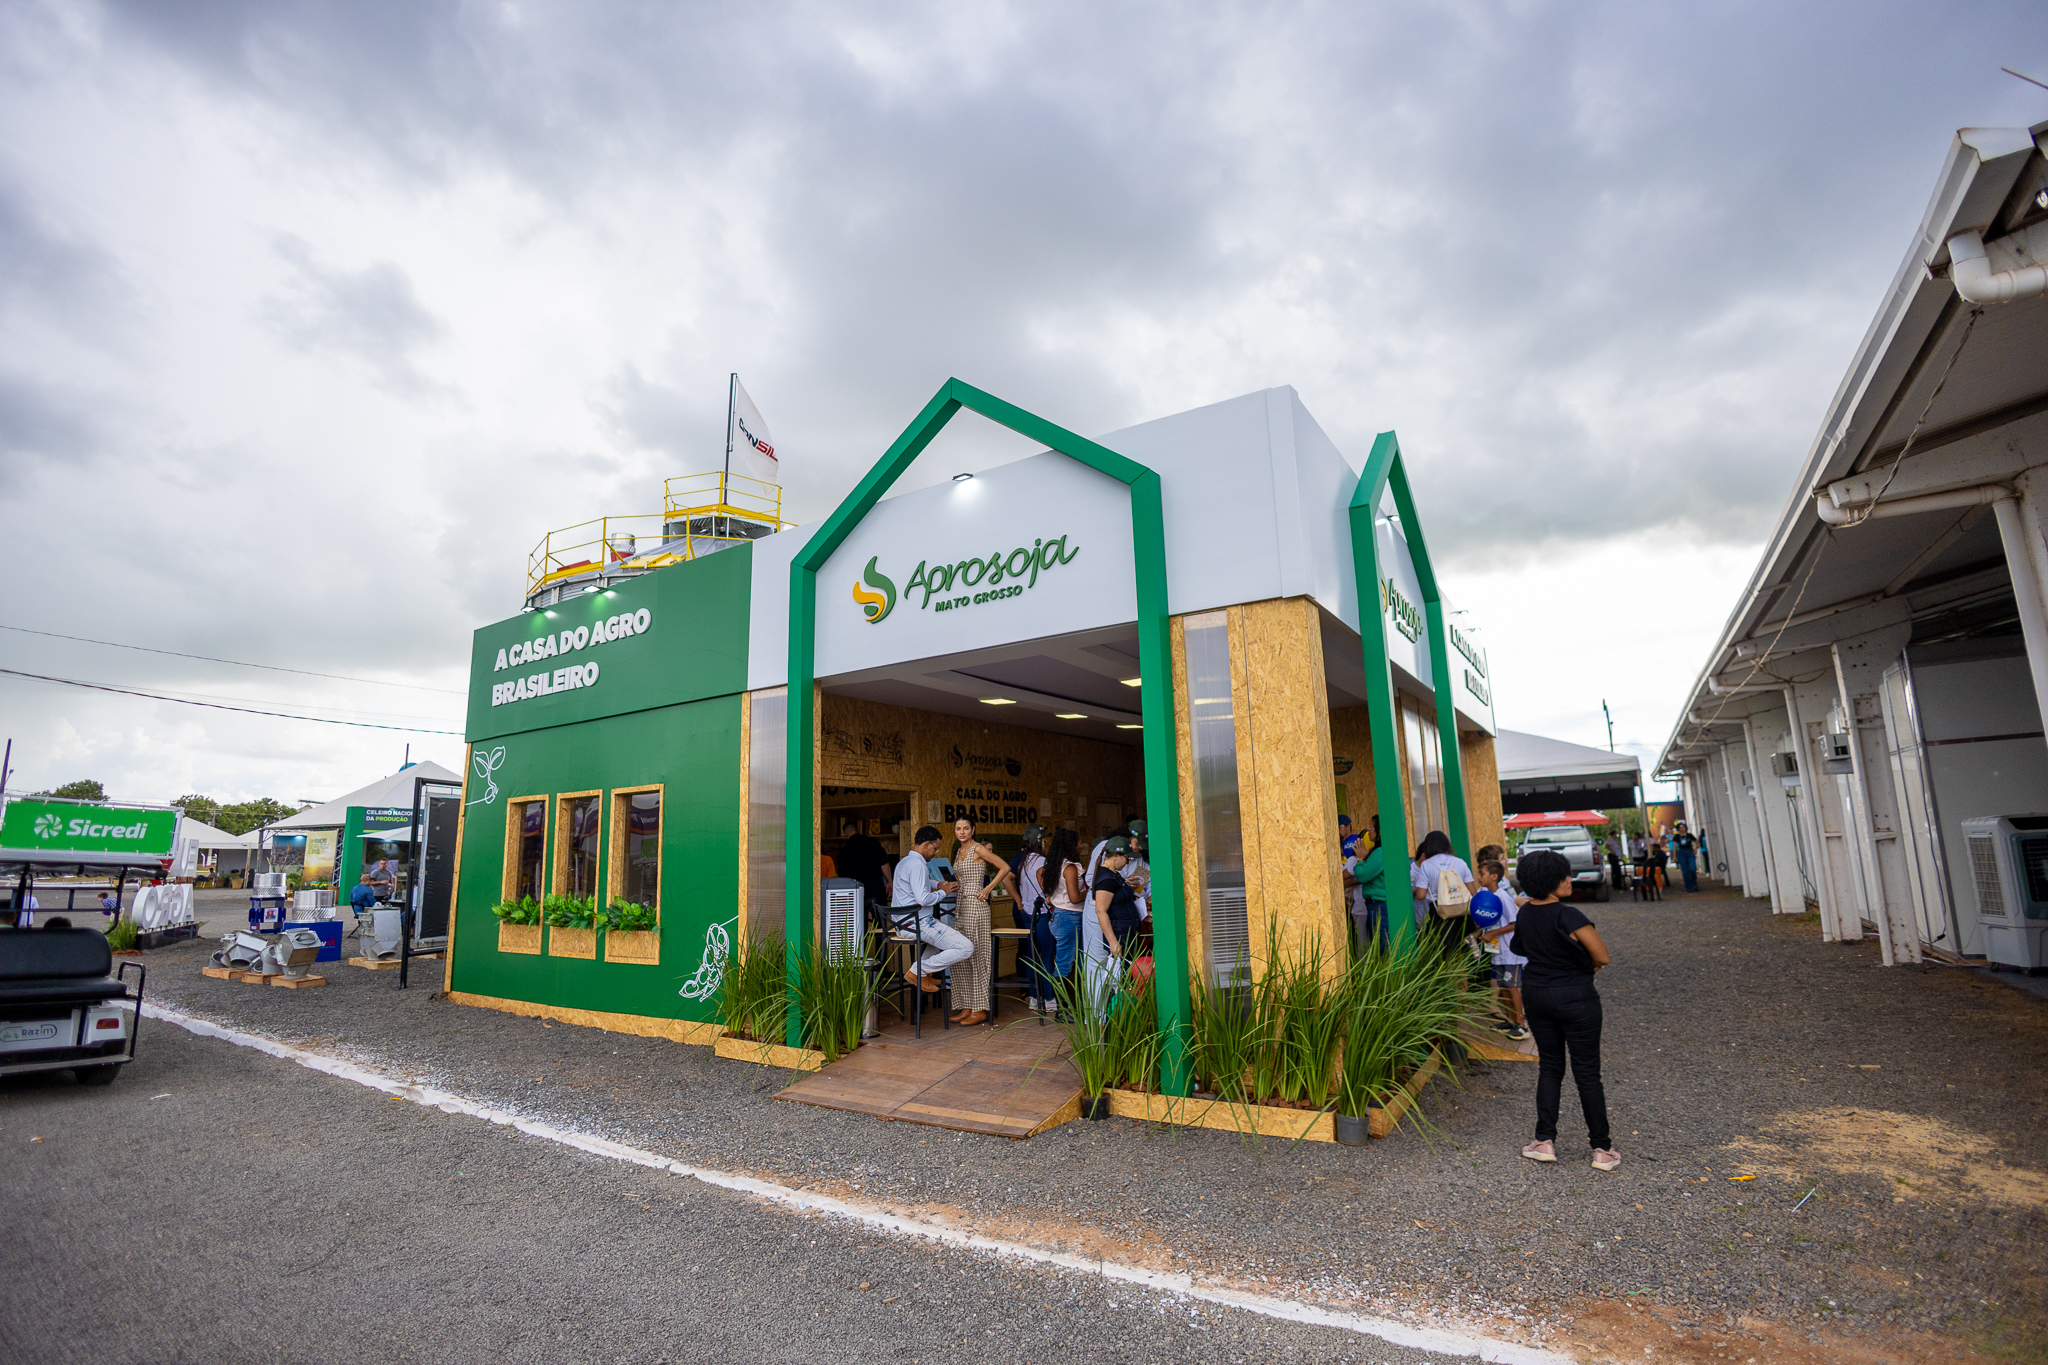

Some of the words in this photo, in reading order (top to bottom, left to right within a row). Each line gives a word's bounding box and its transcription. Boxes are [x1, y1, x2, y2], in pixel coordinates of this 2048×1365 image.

[904, 534, 1079, 609] Aprosoja
[935, 595, 970, 612] MATO
[973, 585, 1023, 604] GROSSO
[494, 648, 508, 672] A
[509, 635, 558, 667] CASA
[559, 626, 589, 654] DO
[590, 608, 652, 647] AGRO
[492, 662, 600, 706] BRASILEIRO
[957, 788, 984, 800] CASA
[987, 790, 1000, 800] DO
[1003, 791, 1027, 802] AGRO
[945, 805, 1037, 823] BRASILEIRO
[66, 819, 148, 839] Sicredi
